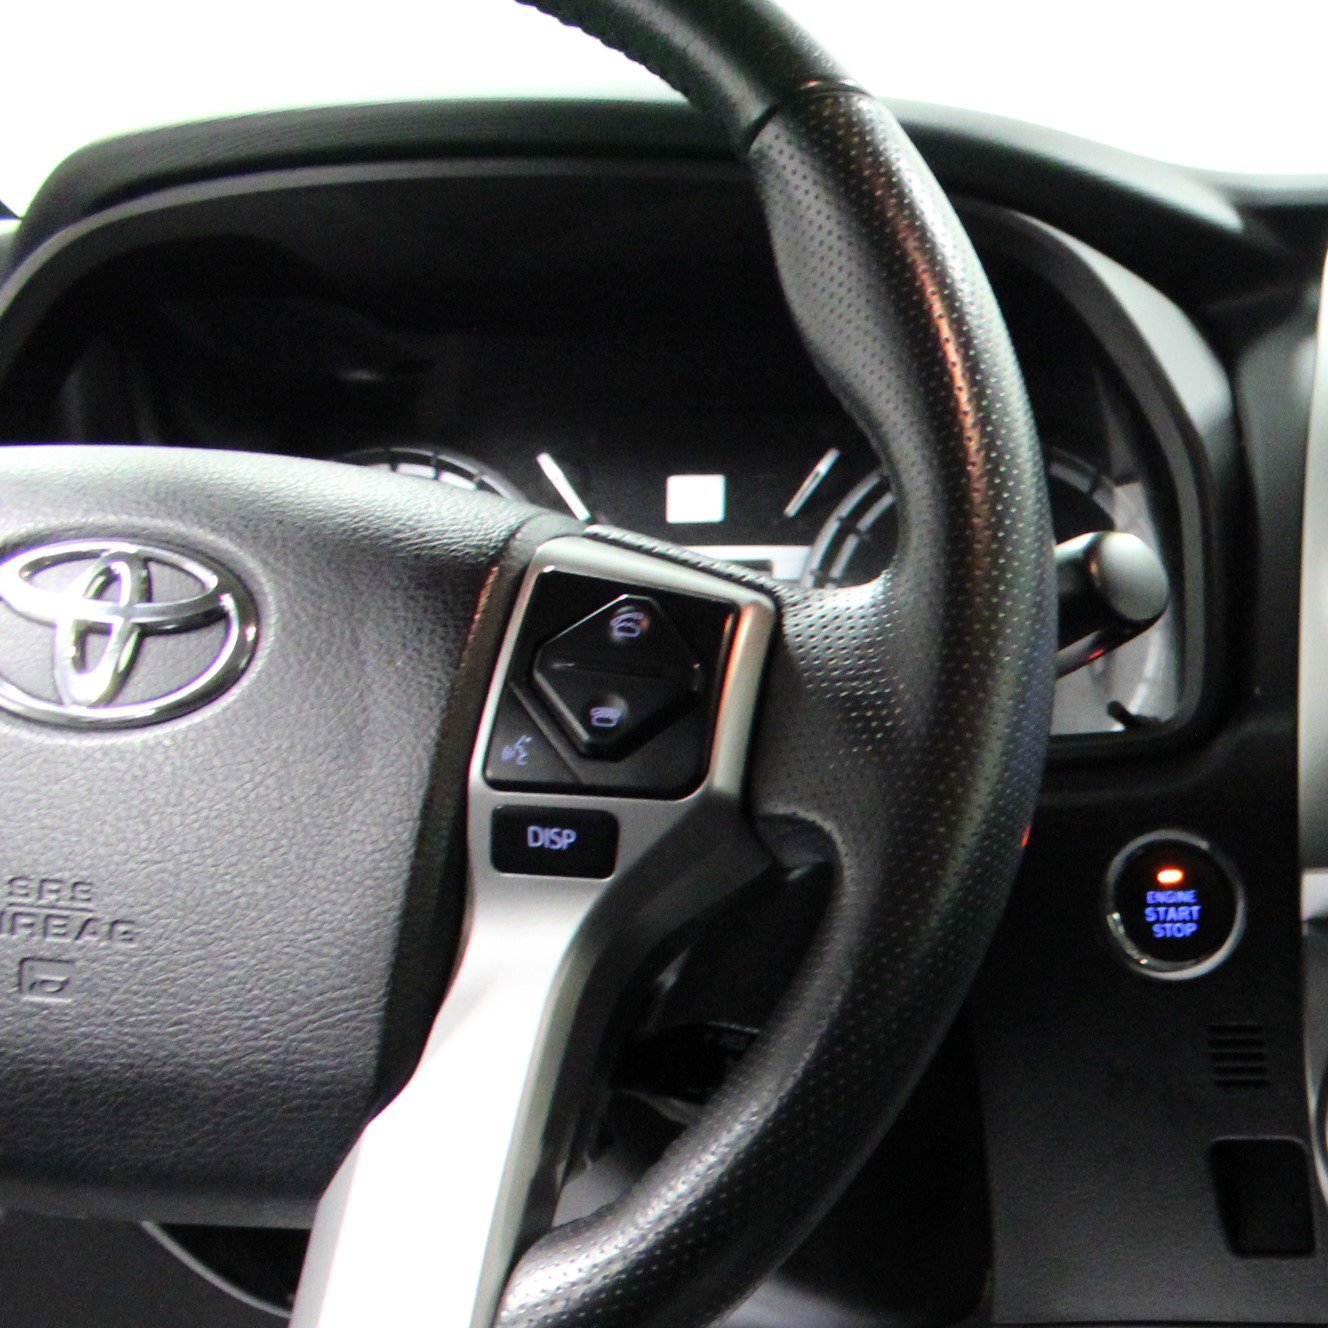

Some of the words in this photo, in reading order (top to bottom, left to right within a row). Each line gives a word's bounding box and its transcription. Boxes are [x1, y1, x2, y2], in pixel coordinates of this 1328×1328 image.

[527, 825, 577, 850] DISP
[1146, 890, 1198, 904] ENGINE
[1144, 906, 1202, 922] START
[1152, 923, 1198, 938] STOP
